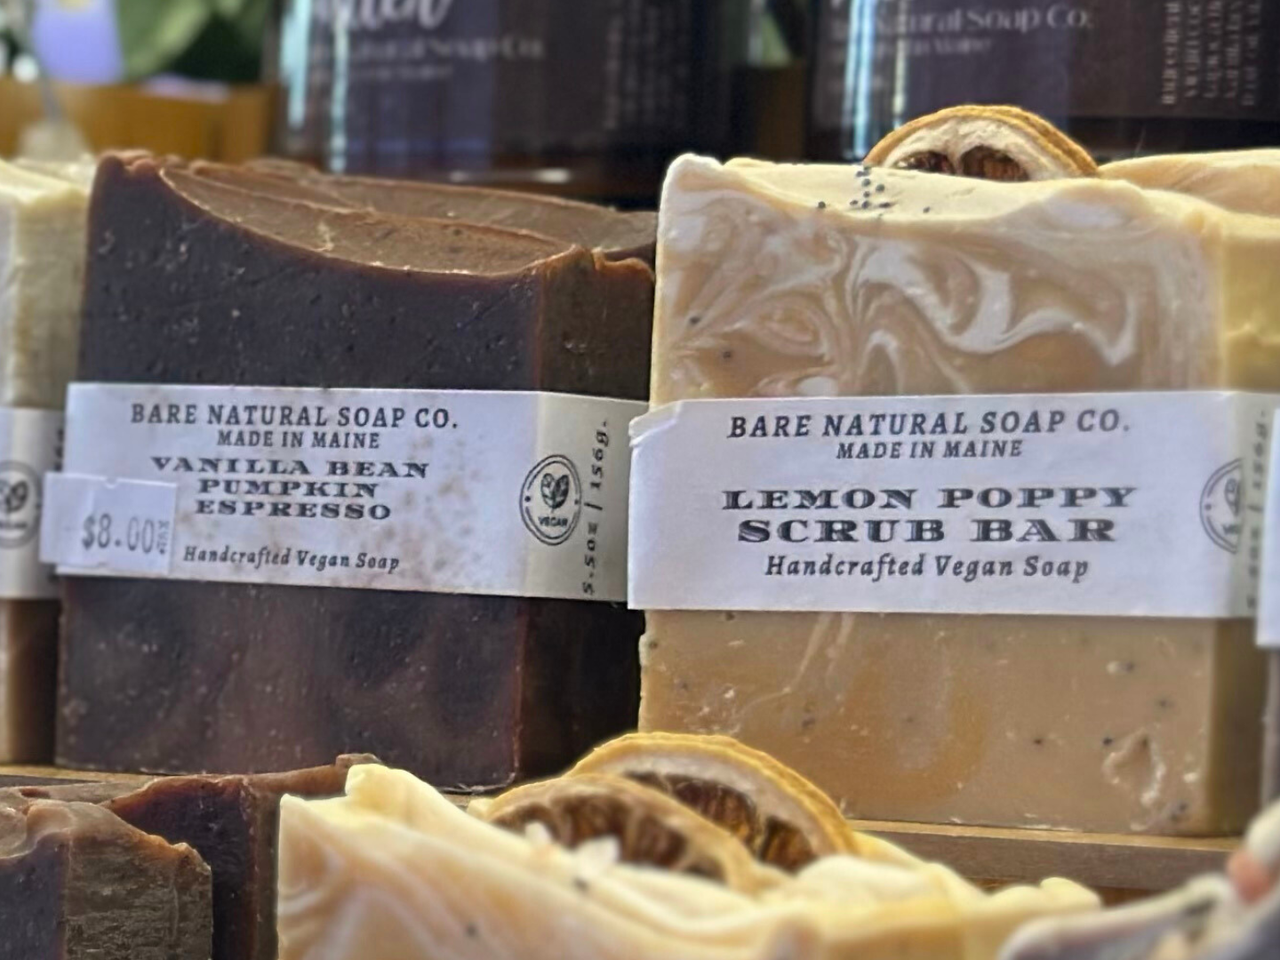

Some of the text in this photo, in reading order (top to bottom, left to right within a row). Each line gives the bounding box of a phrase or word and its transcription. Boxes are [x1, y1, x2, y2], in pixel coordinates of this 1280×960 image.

[131, 403, 460, 430] BARE NATURAL SOAP CO.
[727, 409, 1132, 439] BARE NATURAL SOAP CO.
[217, 430, 381, 451] MADE IN MAINE
[835, 439, 1023, 460] MADE IN MAINE
[150, 456, 430, 479] VANILLA BEAN
[198, 480, 380, 500] PUMPKIN
[721, 486, 1137, 511] LEMON POPPY
[195, 499, 393, 522] ESPRESSO
[737, 518, 1117, 544] SCRUB BAR
[183, 544, 401, 576] Handcrafted Vegan Soap
[765, 553, 1090, 583] Handcrafted Vegan Soap
